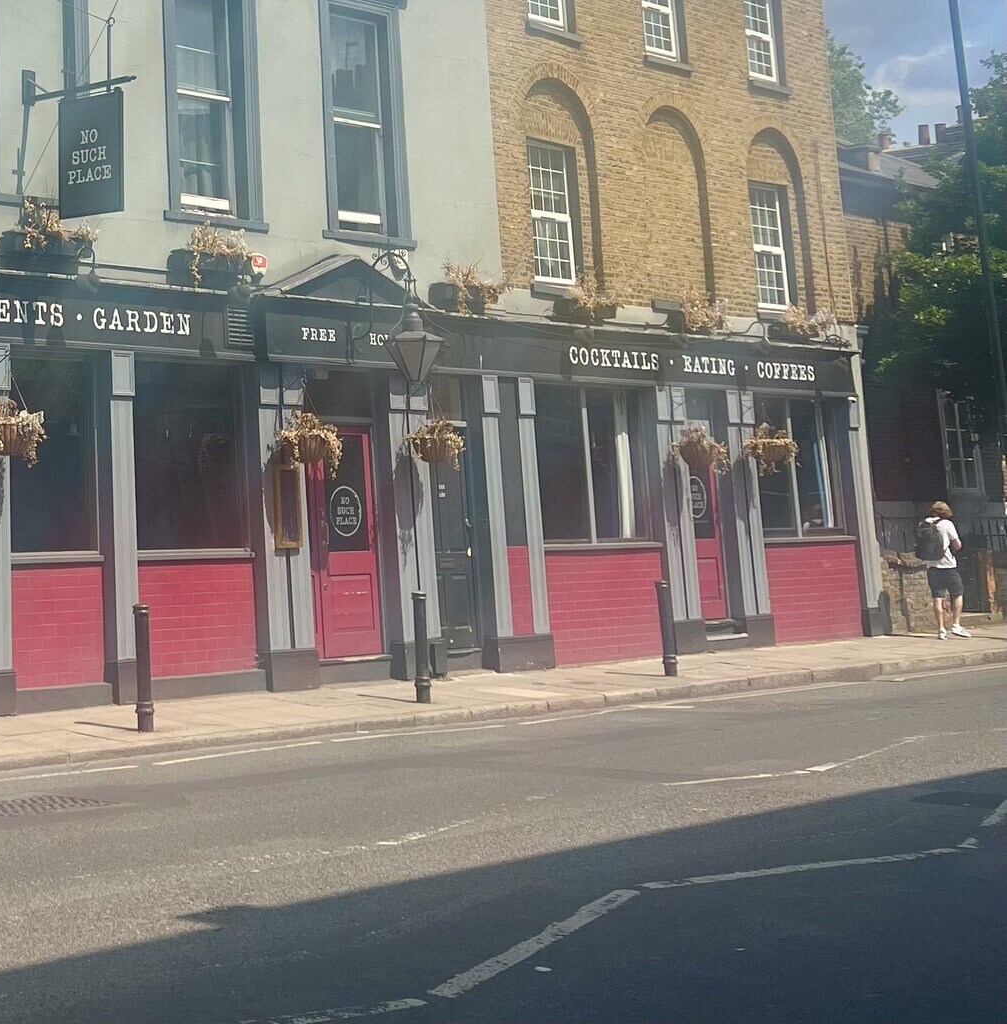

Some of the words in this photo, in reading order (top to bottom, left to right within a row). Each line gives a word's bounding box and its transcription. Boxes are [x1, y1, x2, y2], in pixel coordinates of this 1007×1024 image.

[80, 128, 98, 145] NO
[71, 146, 107, 165] SUCH
[67, 164, 112, 185] PLACE
[93, 307, 192, 336] GARDEN
[301, 327, 337, 342] FREE
[569, 346, 660, 371] COCKTAILS
[682, 354, 736, 376] EATING
[757, 361, 816, 382] COFFEES
[340, 496, 350, 505] NO
[336, 506, 355, 515] SUCH
[335, 516, 358, 525] PLACE
